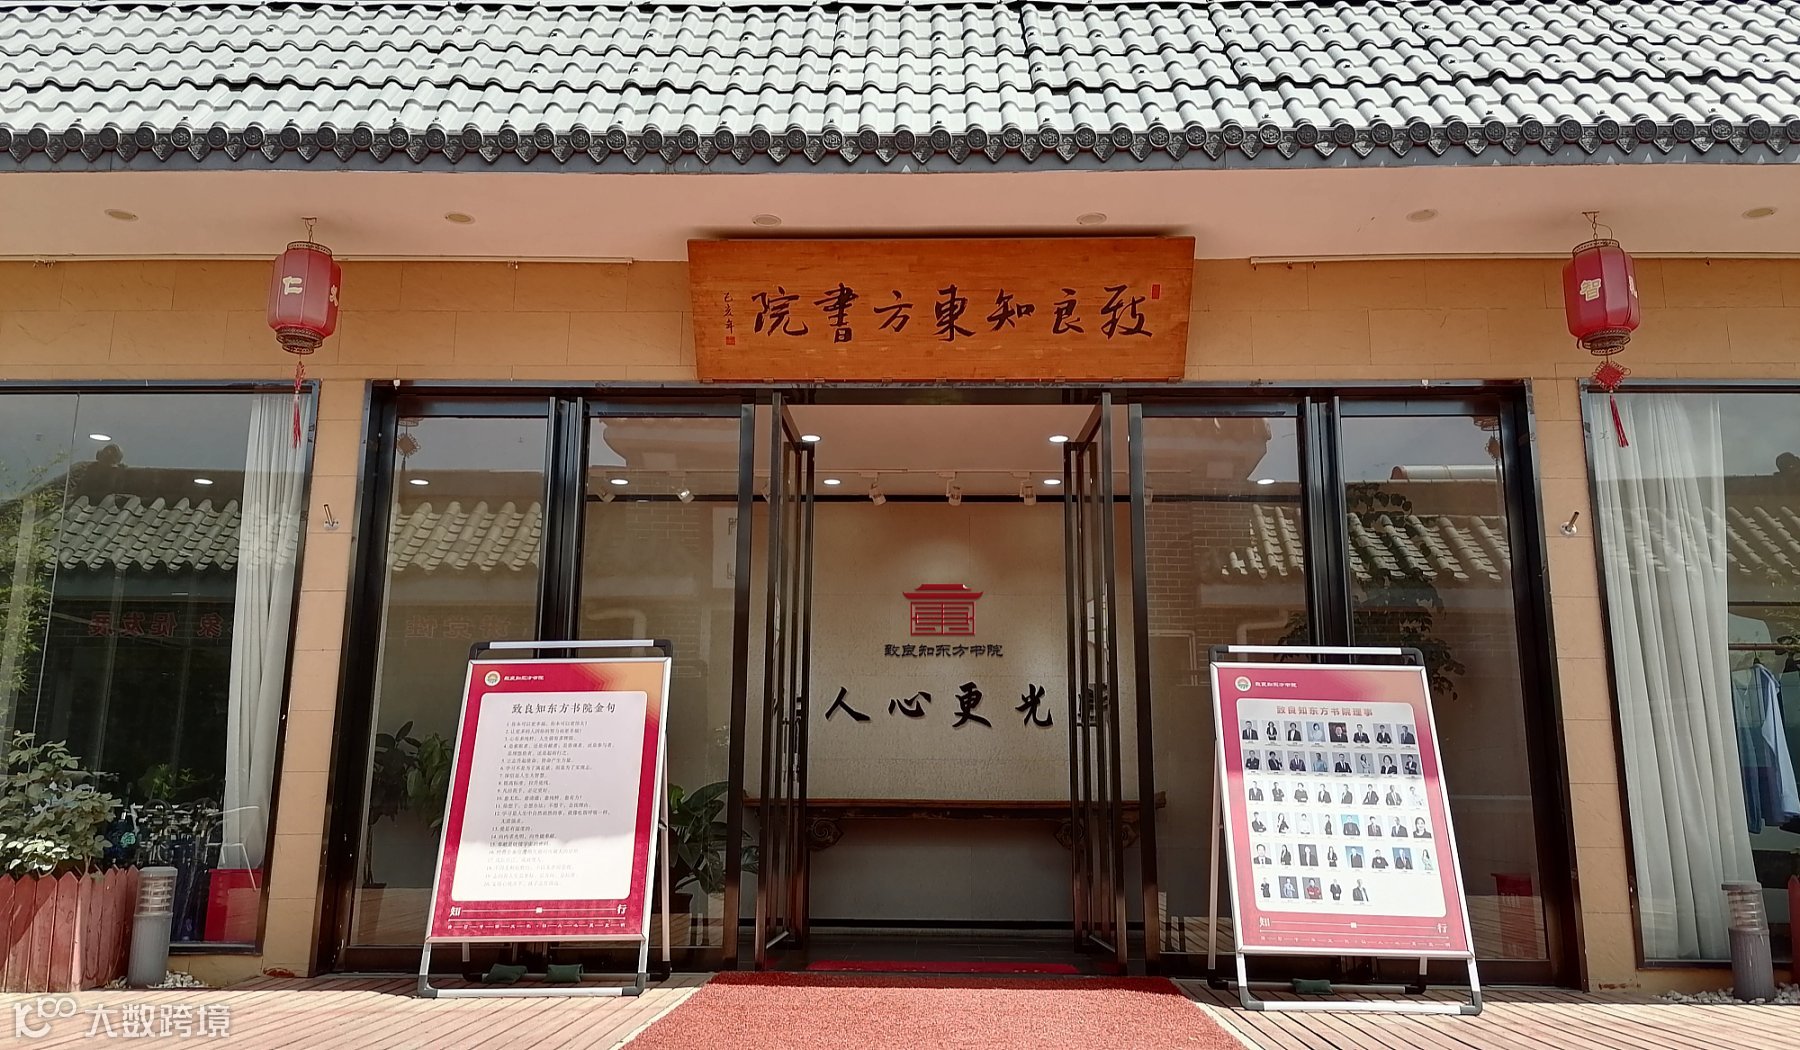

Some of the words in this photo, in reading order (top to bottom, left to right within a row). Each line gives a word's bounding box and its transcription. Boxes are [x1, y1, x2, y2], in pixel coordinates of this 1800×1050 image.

[282, 276, 303, 295] 仁
[1579, 277, 1603, 301] 智
[884, 643, 1004, 659] 致良知东方书院
[511, 702, 616, 715] 致良知东方书院金句
[616, 904, 627, 915] 行
[1436, 922, 1448, 933] 行
